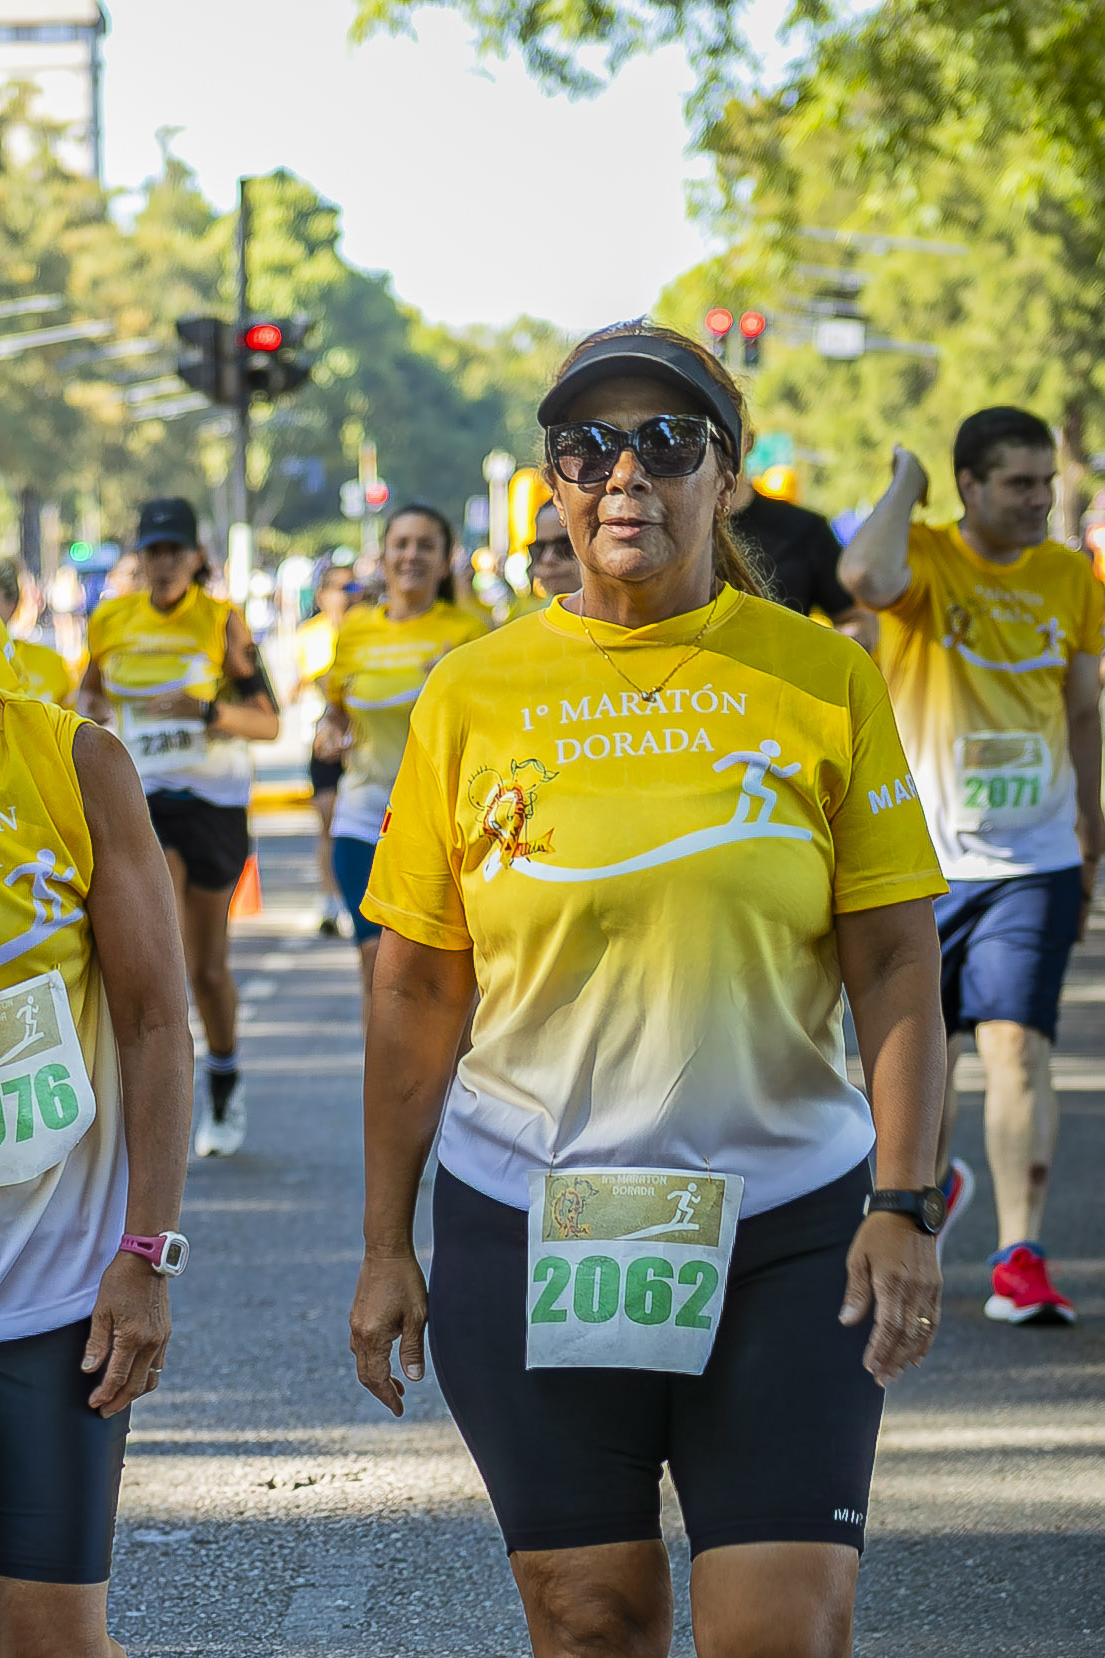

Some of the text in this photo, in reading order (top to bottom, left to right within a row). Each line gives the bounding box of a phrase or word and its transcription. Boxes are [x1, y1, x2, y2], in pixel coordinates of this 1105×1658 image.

[558, 683, 748, 725] MARATÓN
[554, 728, 716, 764] DORADA
[964, 776, 1040, 808] 2071
[612, 1185, 656, 1196] DORADA
[530, 1255, 719, 1330] 2062
